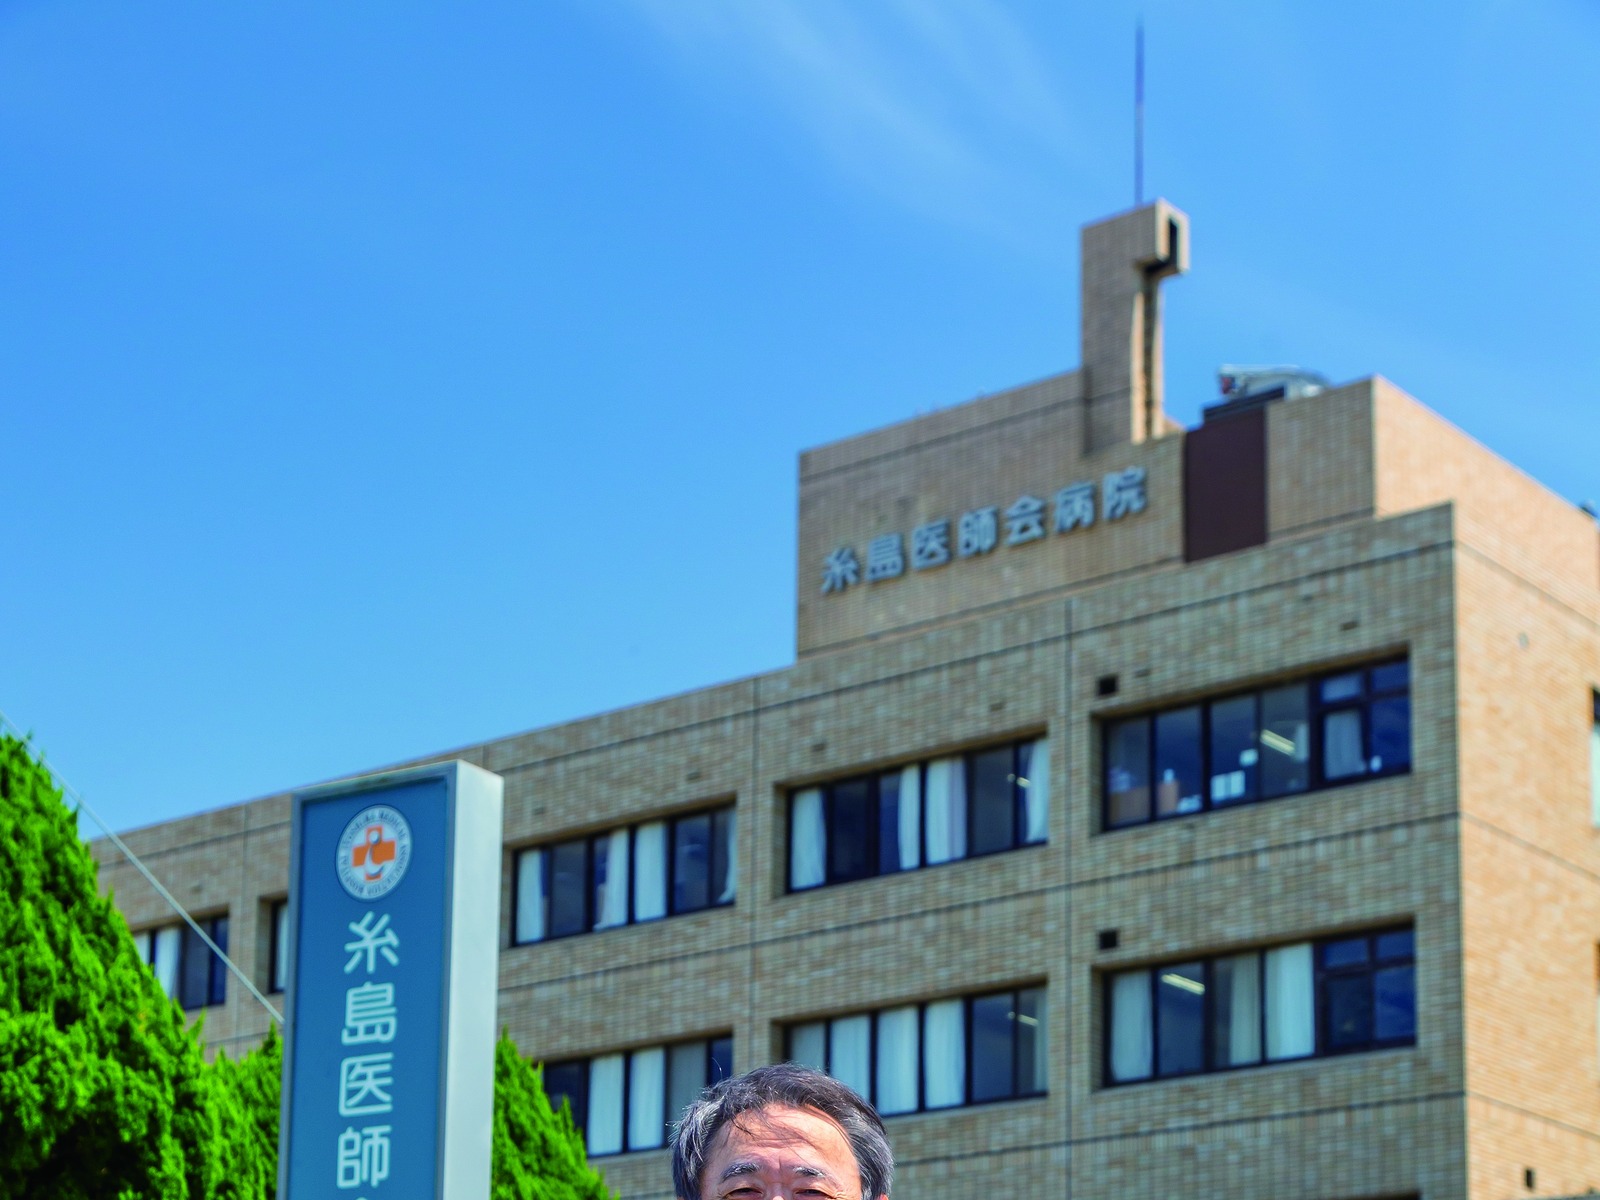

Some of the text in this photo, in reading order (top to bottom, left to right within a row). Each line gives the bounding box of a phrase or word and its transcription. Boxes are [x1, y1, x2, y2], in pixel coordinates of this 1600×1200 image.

[821, 466, 1147, 593] 糸島医師会病院
